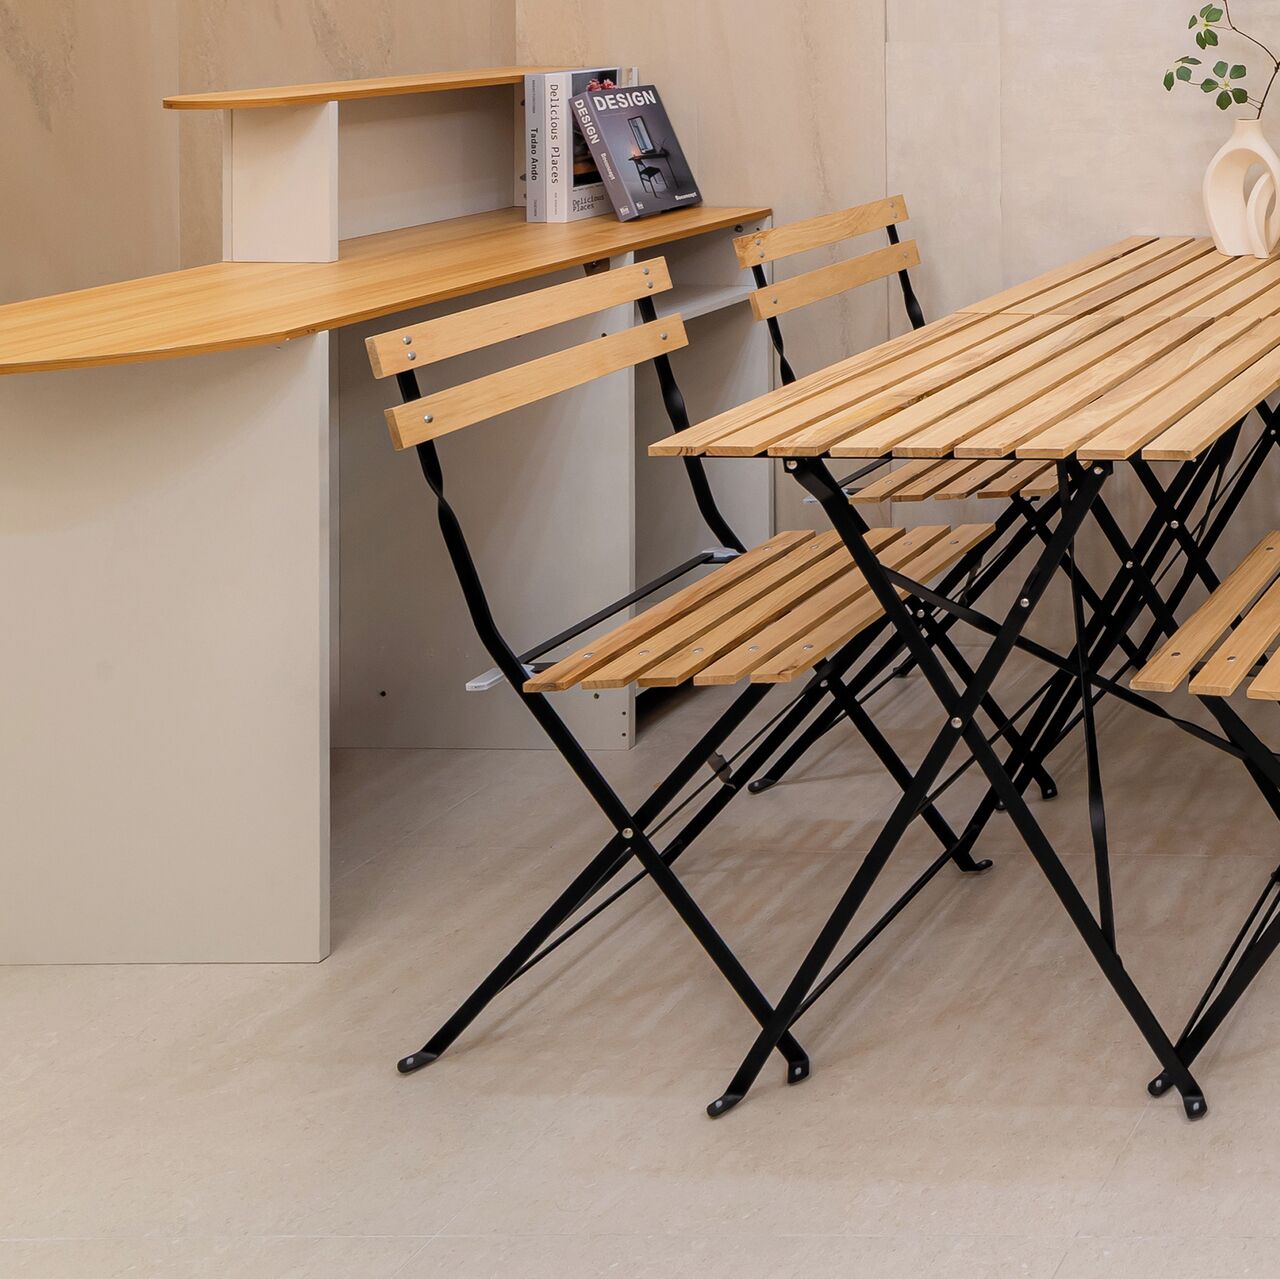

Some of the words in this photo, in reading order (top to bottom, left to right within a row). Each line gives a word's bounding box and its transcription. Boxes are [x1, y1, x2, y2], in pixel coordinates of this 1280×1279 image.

[549, 84, 560, 141] Delicious
[593, 90, 657, 111] DESIGN
[574, 99, 600, 145] DESIGN
[530, 127, 539, 155] Tadao
[530, 157, 539, 181] Ando
[550, 146, 560, 184] Places
